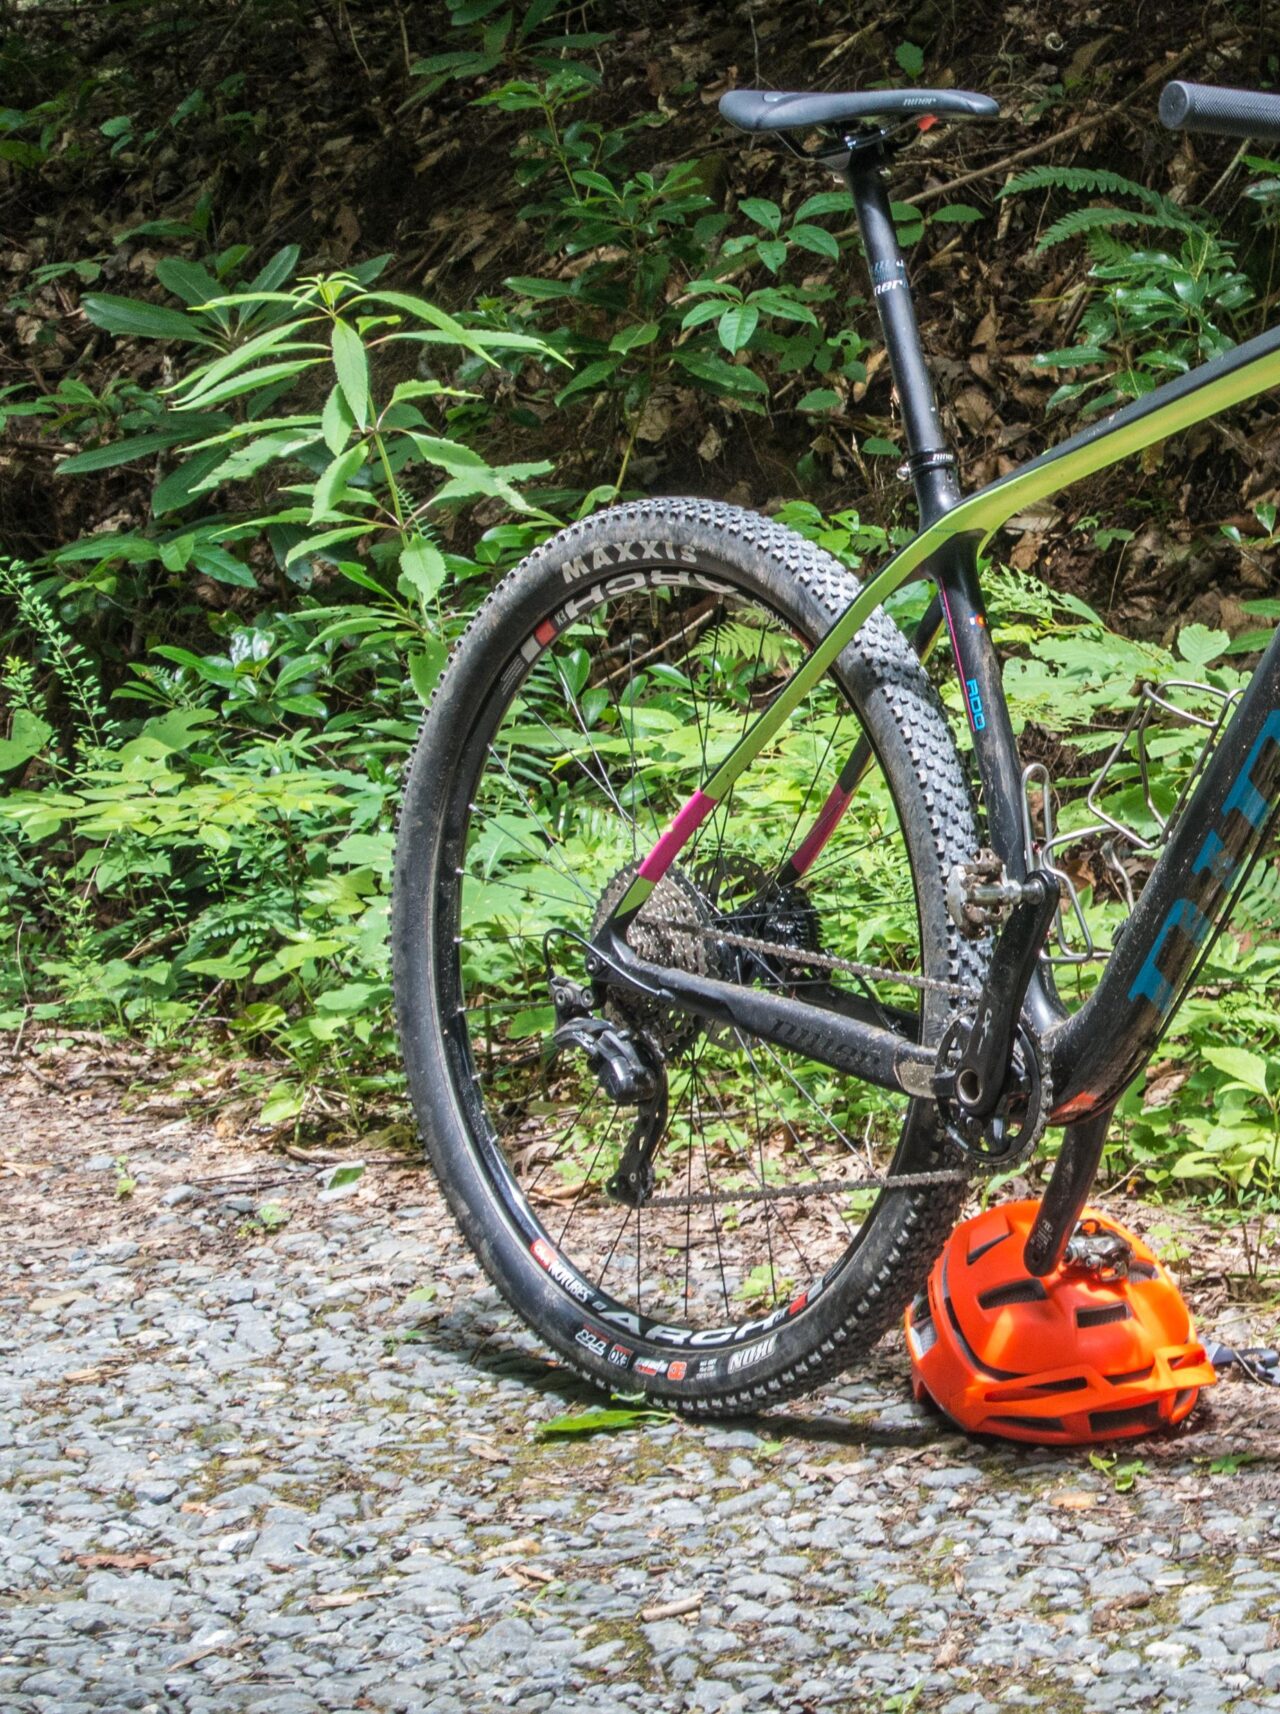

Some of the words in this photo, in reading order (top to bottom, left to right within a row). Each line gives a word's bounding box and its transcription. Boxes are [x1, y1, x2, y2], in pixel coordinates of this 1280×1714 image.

[561, 541, 697, 584] MAXXIS
[564, 569, 737, 619] ARCH
[966, 678, 986, 731] RDO
[548, 1260, 594, 1303] NOTUBES
[598, 1311, 779, 1345] ARCH
[728, 1333, 778, 1375] IKON
